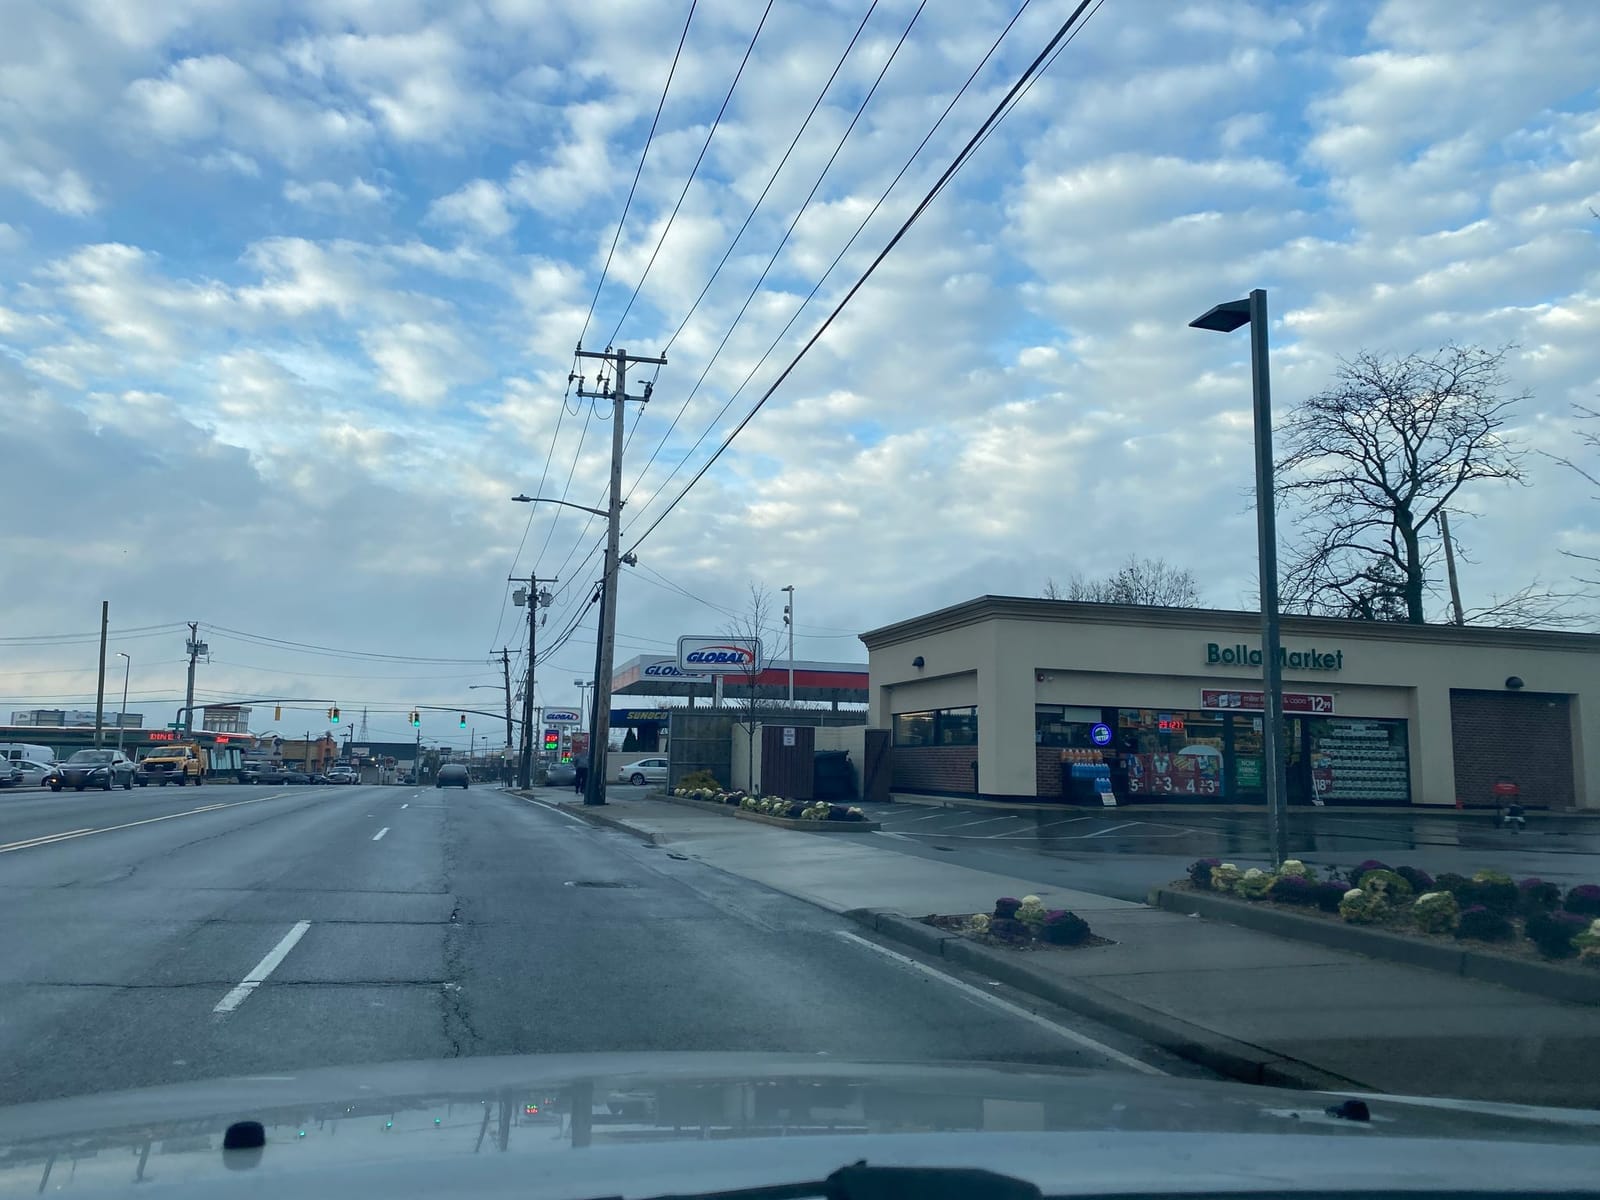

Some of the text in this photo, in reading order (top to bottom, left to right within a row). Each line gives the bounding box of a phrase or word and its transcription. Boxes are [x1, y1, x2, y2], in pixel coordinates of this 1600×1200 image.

[686, 651, 745, 664] GLOBAL
[1207, 642, 1262, 664] Bolla
[546, 713, 575, 721] GLOBAL
[627, 711, 668, 720] SUNOCO
